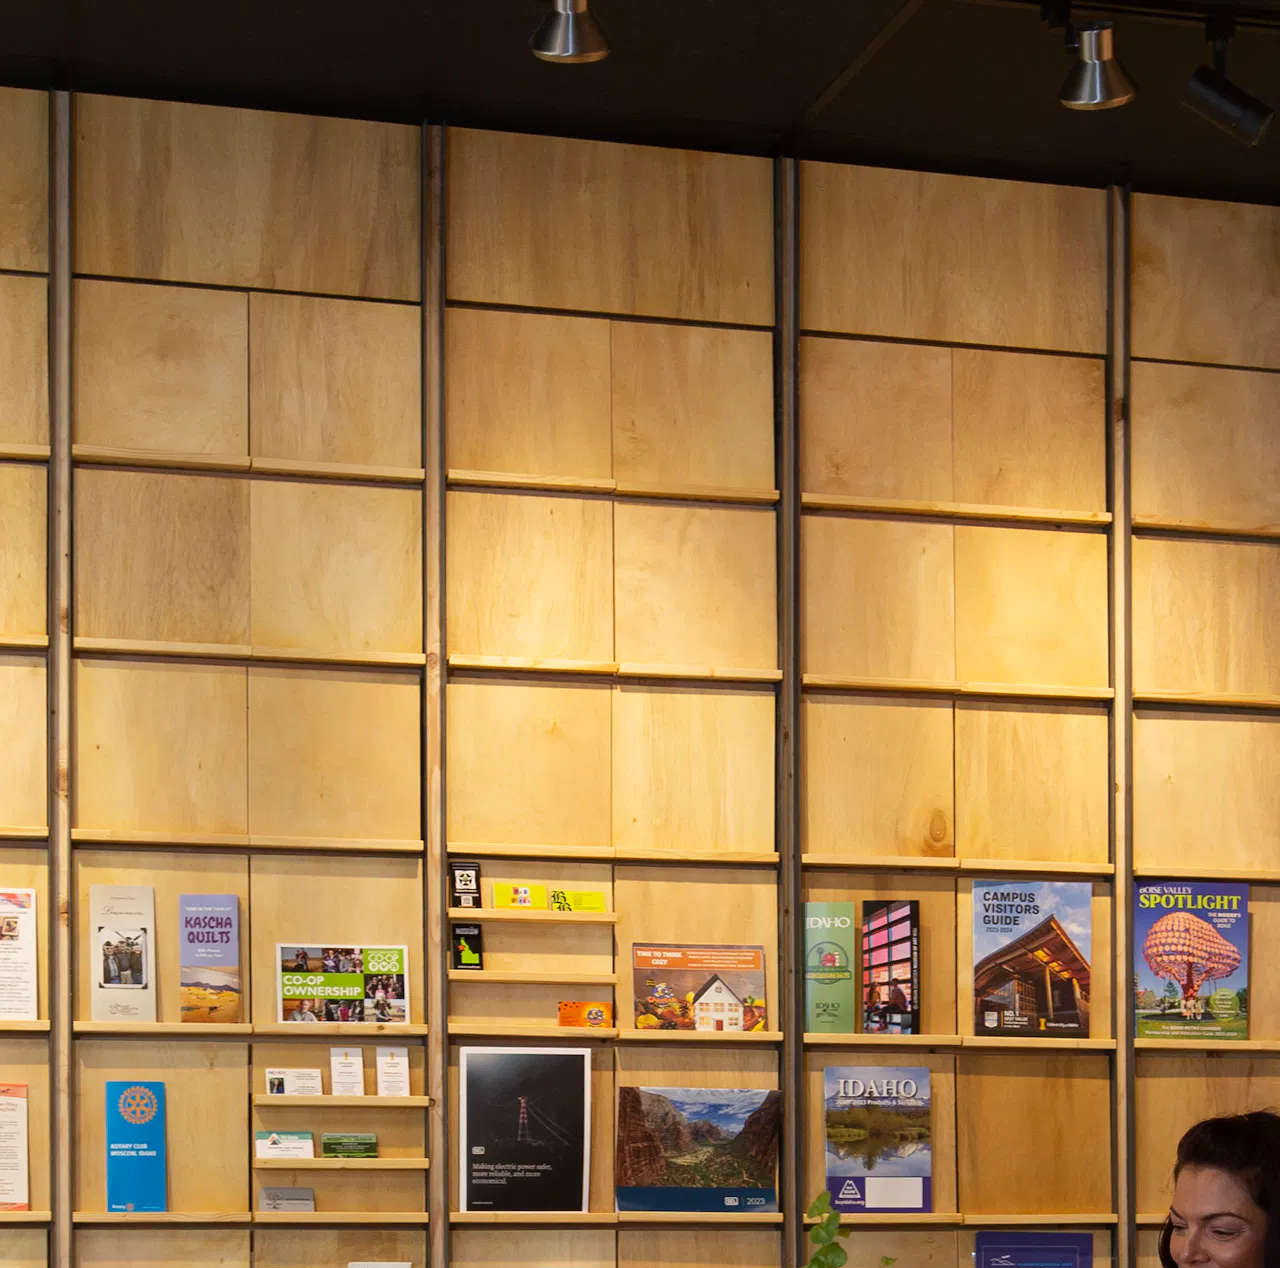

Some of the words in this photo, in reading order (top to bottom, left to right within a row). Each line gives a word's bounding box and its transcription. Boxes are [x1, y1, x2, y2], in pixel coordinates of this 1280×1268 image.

[1164, 886, 1193, 895] VALLEY
[983, 891, 1036, 903] CAMPUS
[1138, 893, 1242, 910] SPOTLIGHT
[983, 903, 1040, 915] VISITORS
[184, 915, 233, 929] KASCHA
[805, 916, 851, 930] IDAHO
[983, 914, 1020, 926] GUIDE
[187, 931, 232, 944] QUILTS
[283, 975, 325, 985] CO-OP
[283, 985, 362, 997] OWNERSHIP
[838, 1079, 919, 1098] IDAHO
[472, 1163, 495, 1171] Making
[517, 1163, 536, 1171] power
[747, 1197, 766, 1206] 2023
